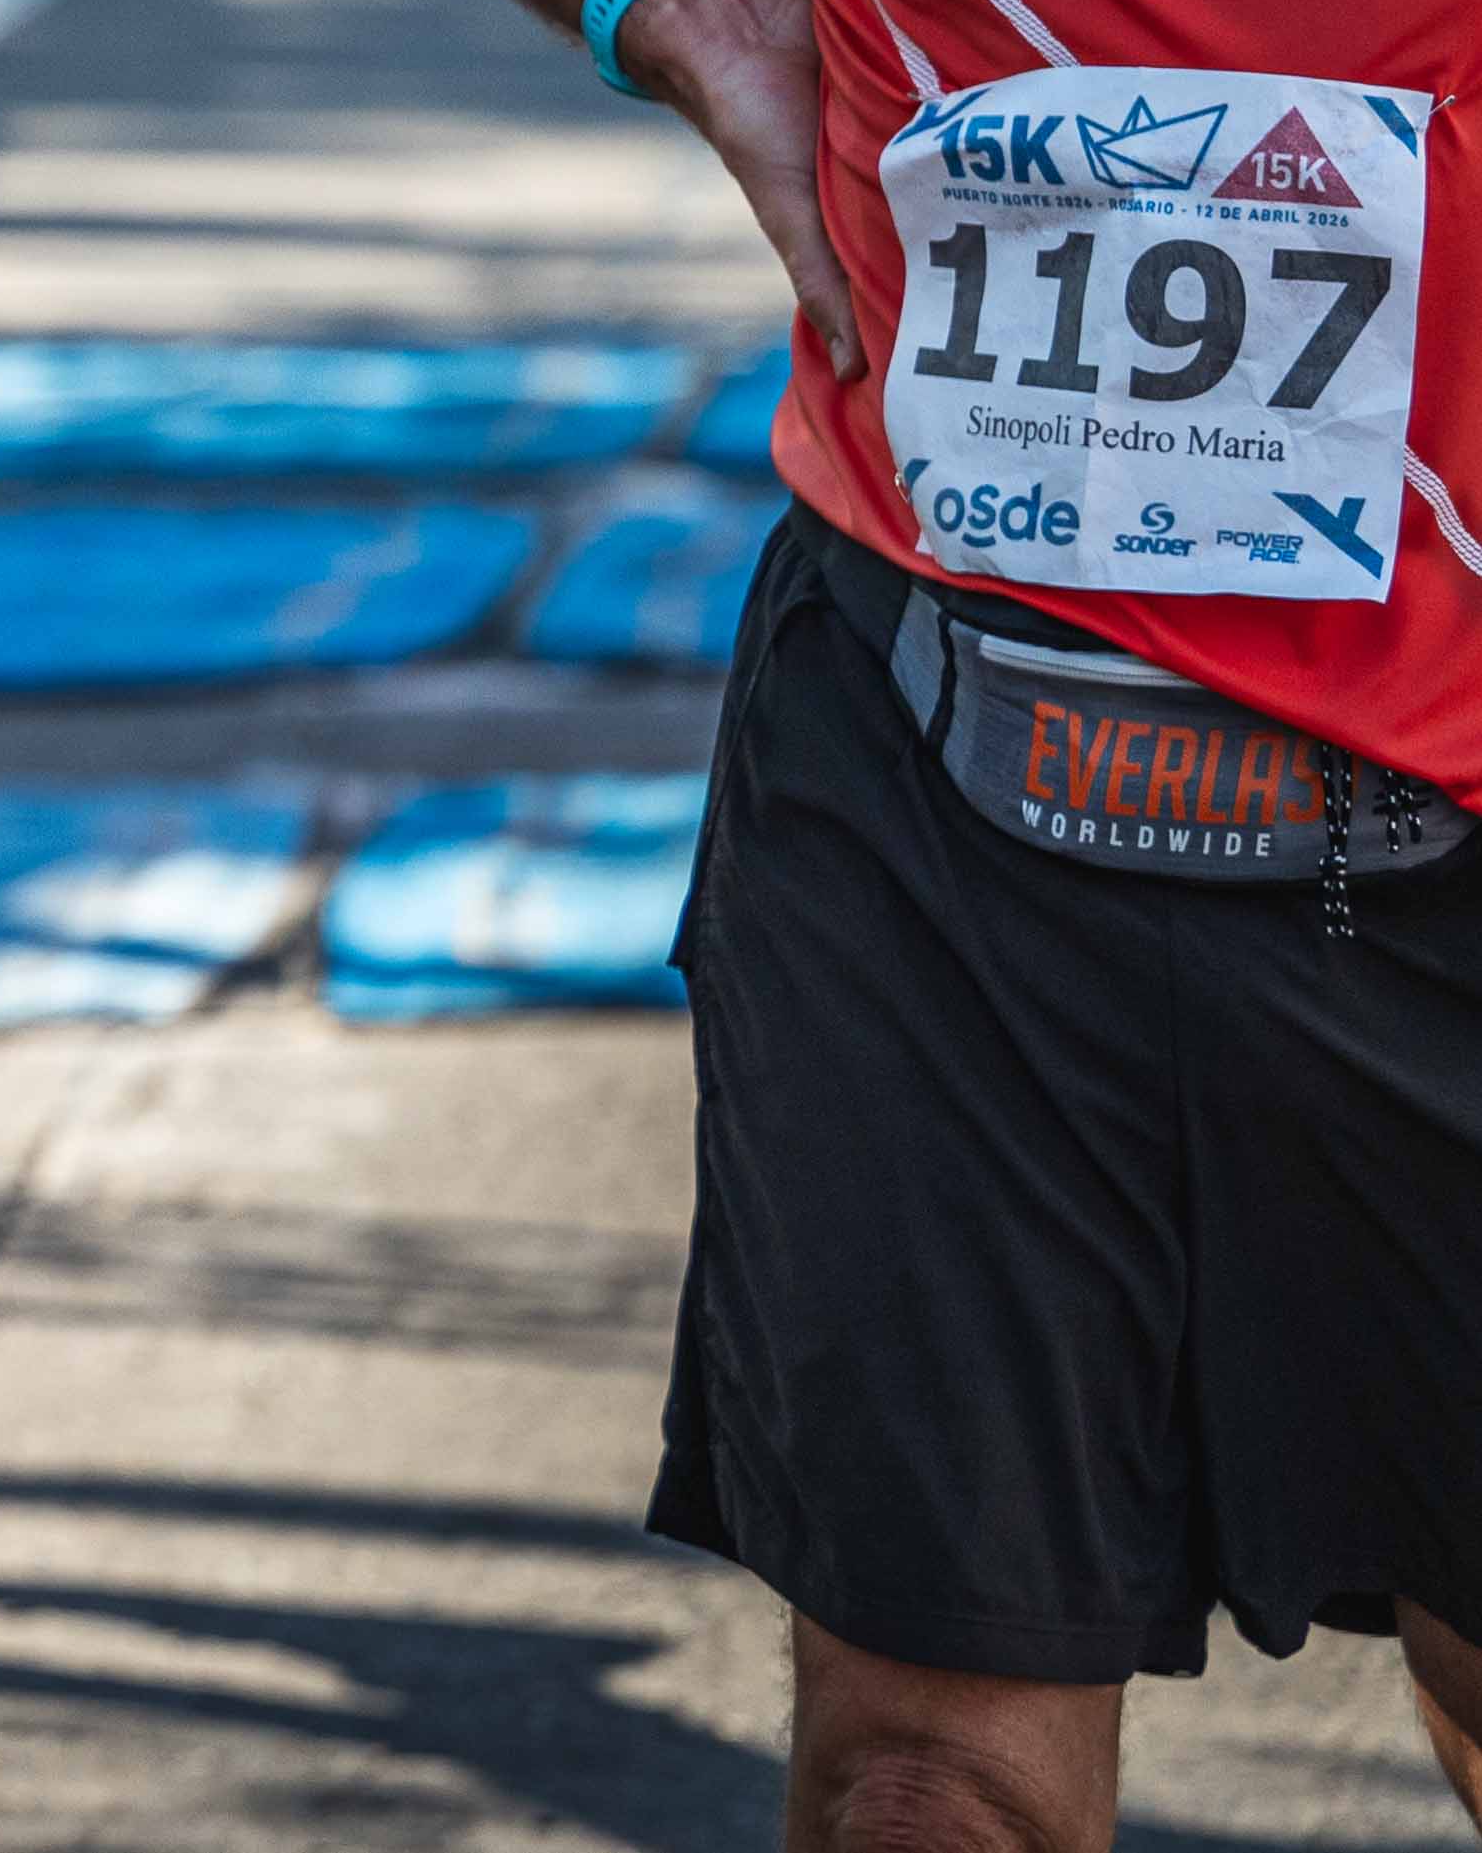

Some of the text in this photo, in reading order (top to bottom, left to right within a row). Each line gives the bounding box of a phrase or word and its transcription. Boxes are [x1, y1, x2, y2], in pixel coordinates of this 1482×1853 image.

[934, 114, 1065, 186] 15K
[1251, 151, 1329, 194] 15K
[943, 187, 997, 205] PUERTO
[1002, 192, 1050, 207] NORTE
[1109, 197, 1174, 216] ROSARIO
[1195, 205, 1214, 218] 12
[1220, 207, 1241, 221] DE
[1248, 208, 1299, 224] ABRIL
[1307, 211, 1350, 228] 2026
[913, 222, 1393, 410] 1197
[966, 405, 1286, 463] Sinopoli Pedro Maria
[933, 482, 1081, 546] osde
[1217, 530, 1303, 550] POWER
[1022, 799, 1272, 857] WORLDWIDE
